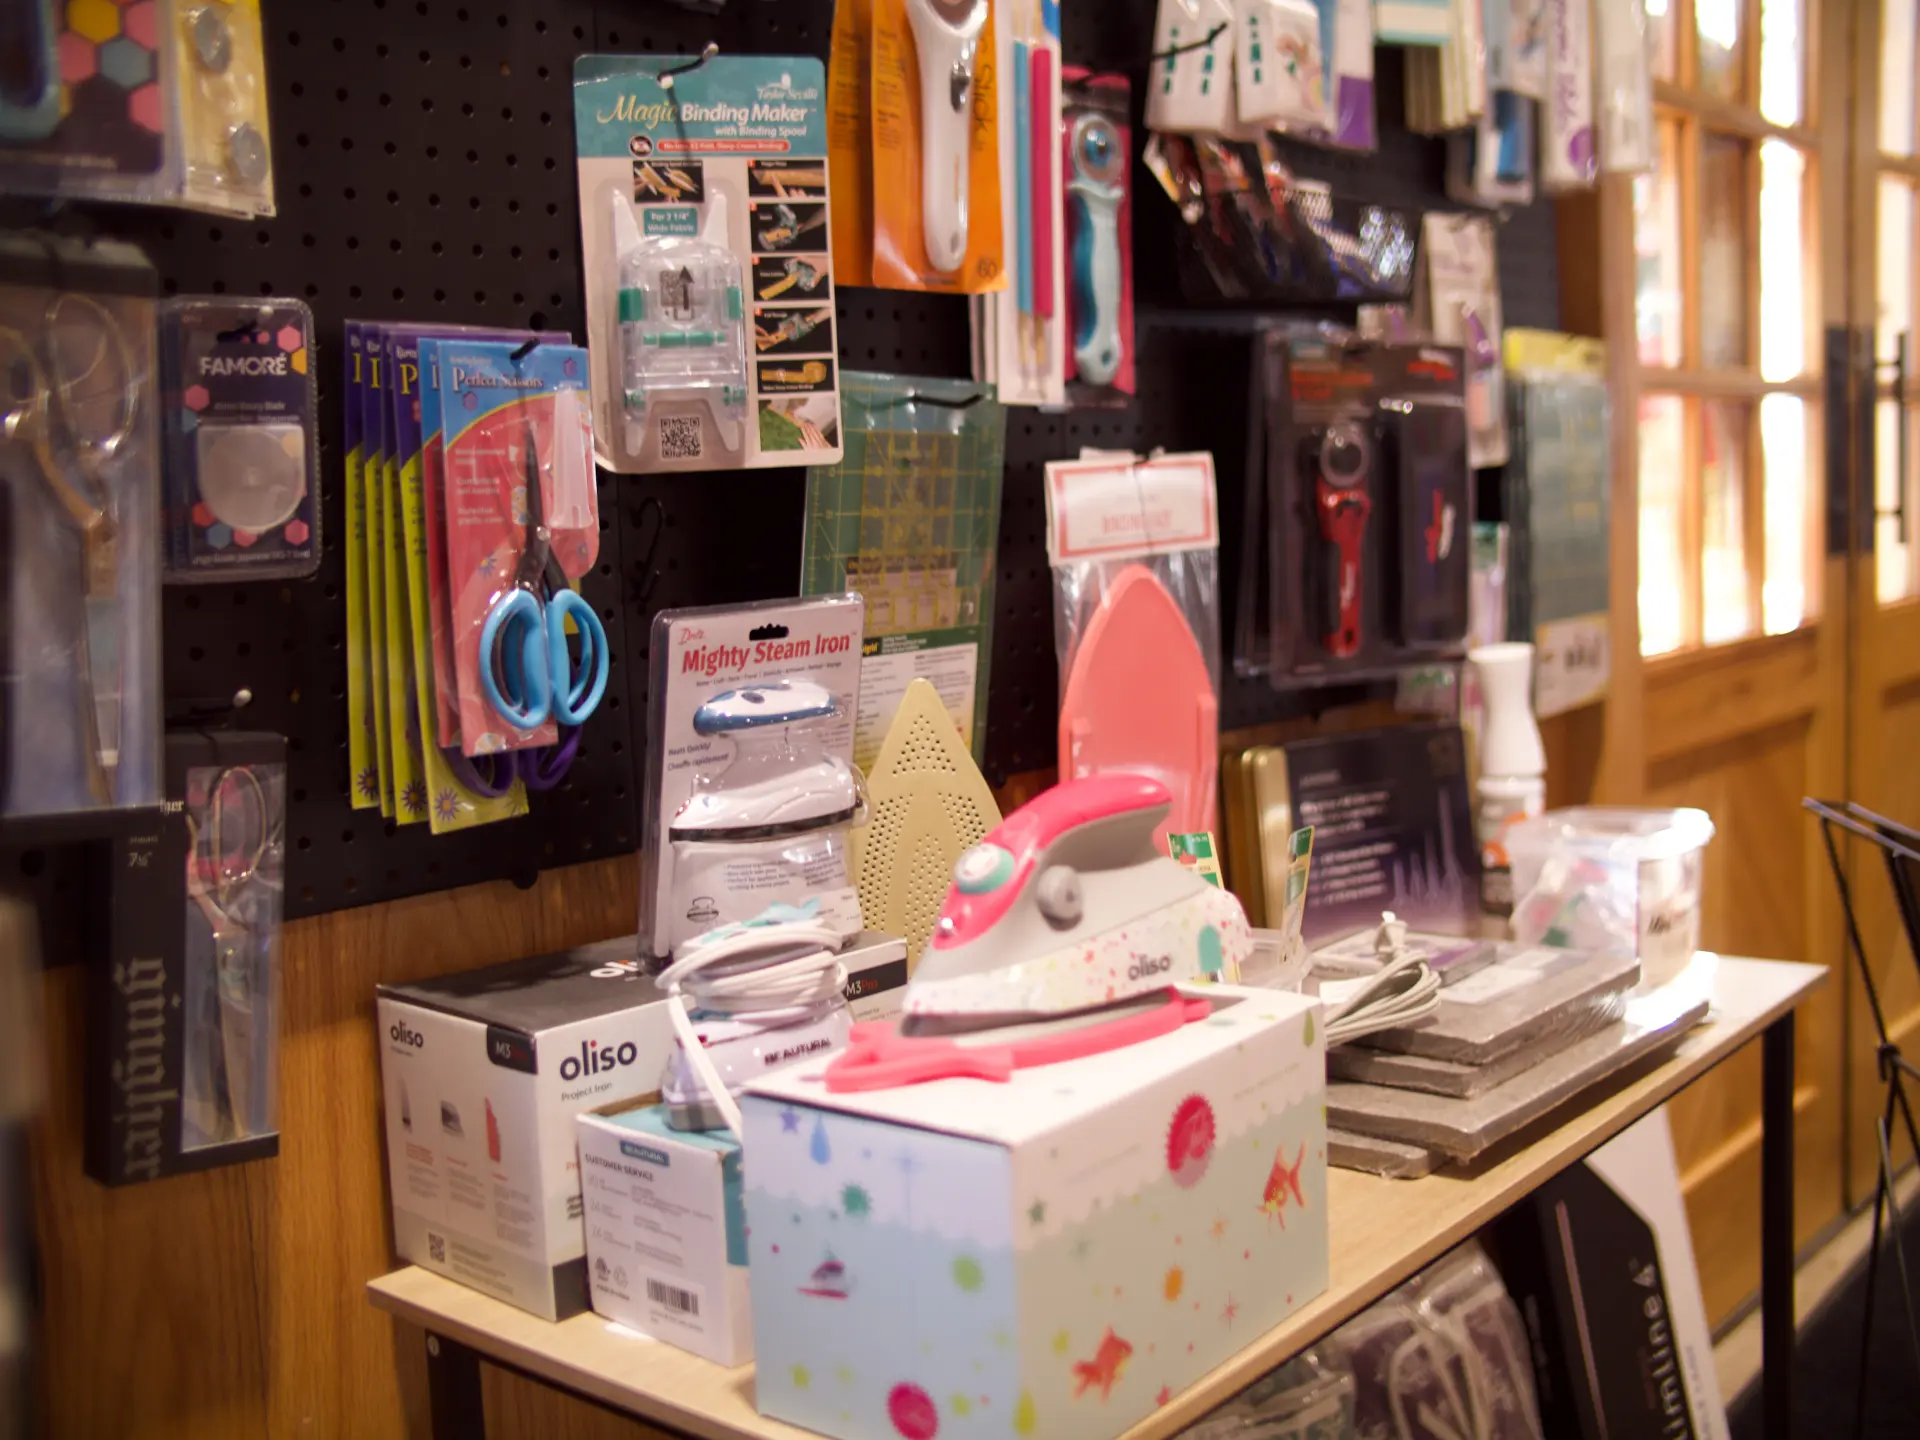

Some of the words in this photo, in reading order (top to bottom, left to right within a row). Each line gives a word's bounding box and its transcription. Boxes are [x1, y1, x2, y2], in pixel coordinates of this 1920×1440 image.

[597, 94, 677, 129] Magic
[681, 102, 749, 125] Binding
[751, 102, 807, 122] Maker
[715, 126, 737, 136] with
[739, 126, 776, 137] Binding
[779, 126, 807, 140] Spool
[201, 352, 287, 376] FAMORÉ
[451, 367, 498, 392] Perfect
[500, 372, 543, 388] Scissors
[681, 644, 750, 676] Mighty
[754, 639, 811, 664] Steam
[814, 632, 850, 656] Iron
[668, 745, 685, 756] Heats
[590, 959, 640, 978] oli
[1127, 953, 1172, 981] oliso
[390, 1020, 424, 1048] oliso
[560, 1039, 637, 1081] oliso
[561, 1084, 593, 1102] Project
[595, 1081, 613, 1093] Iron
[585, 1153, 622, 1173] CUSTOMER
[623, 1166, 654, 1182] SERVICE
